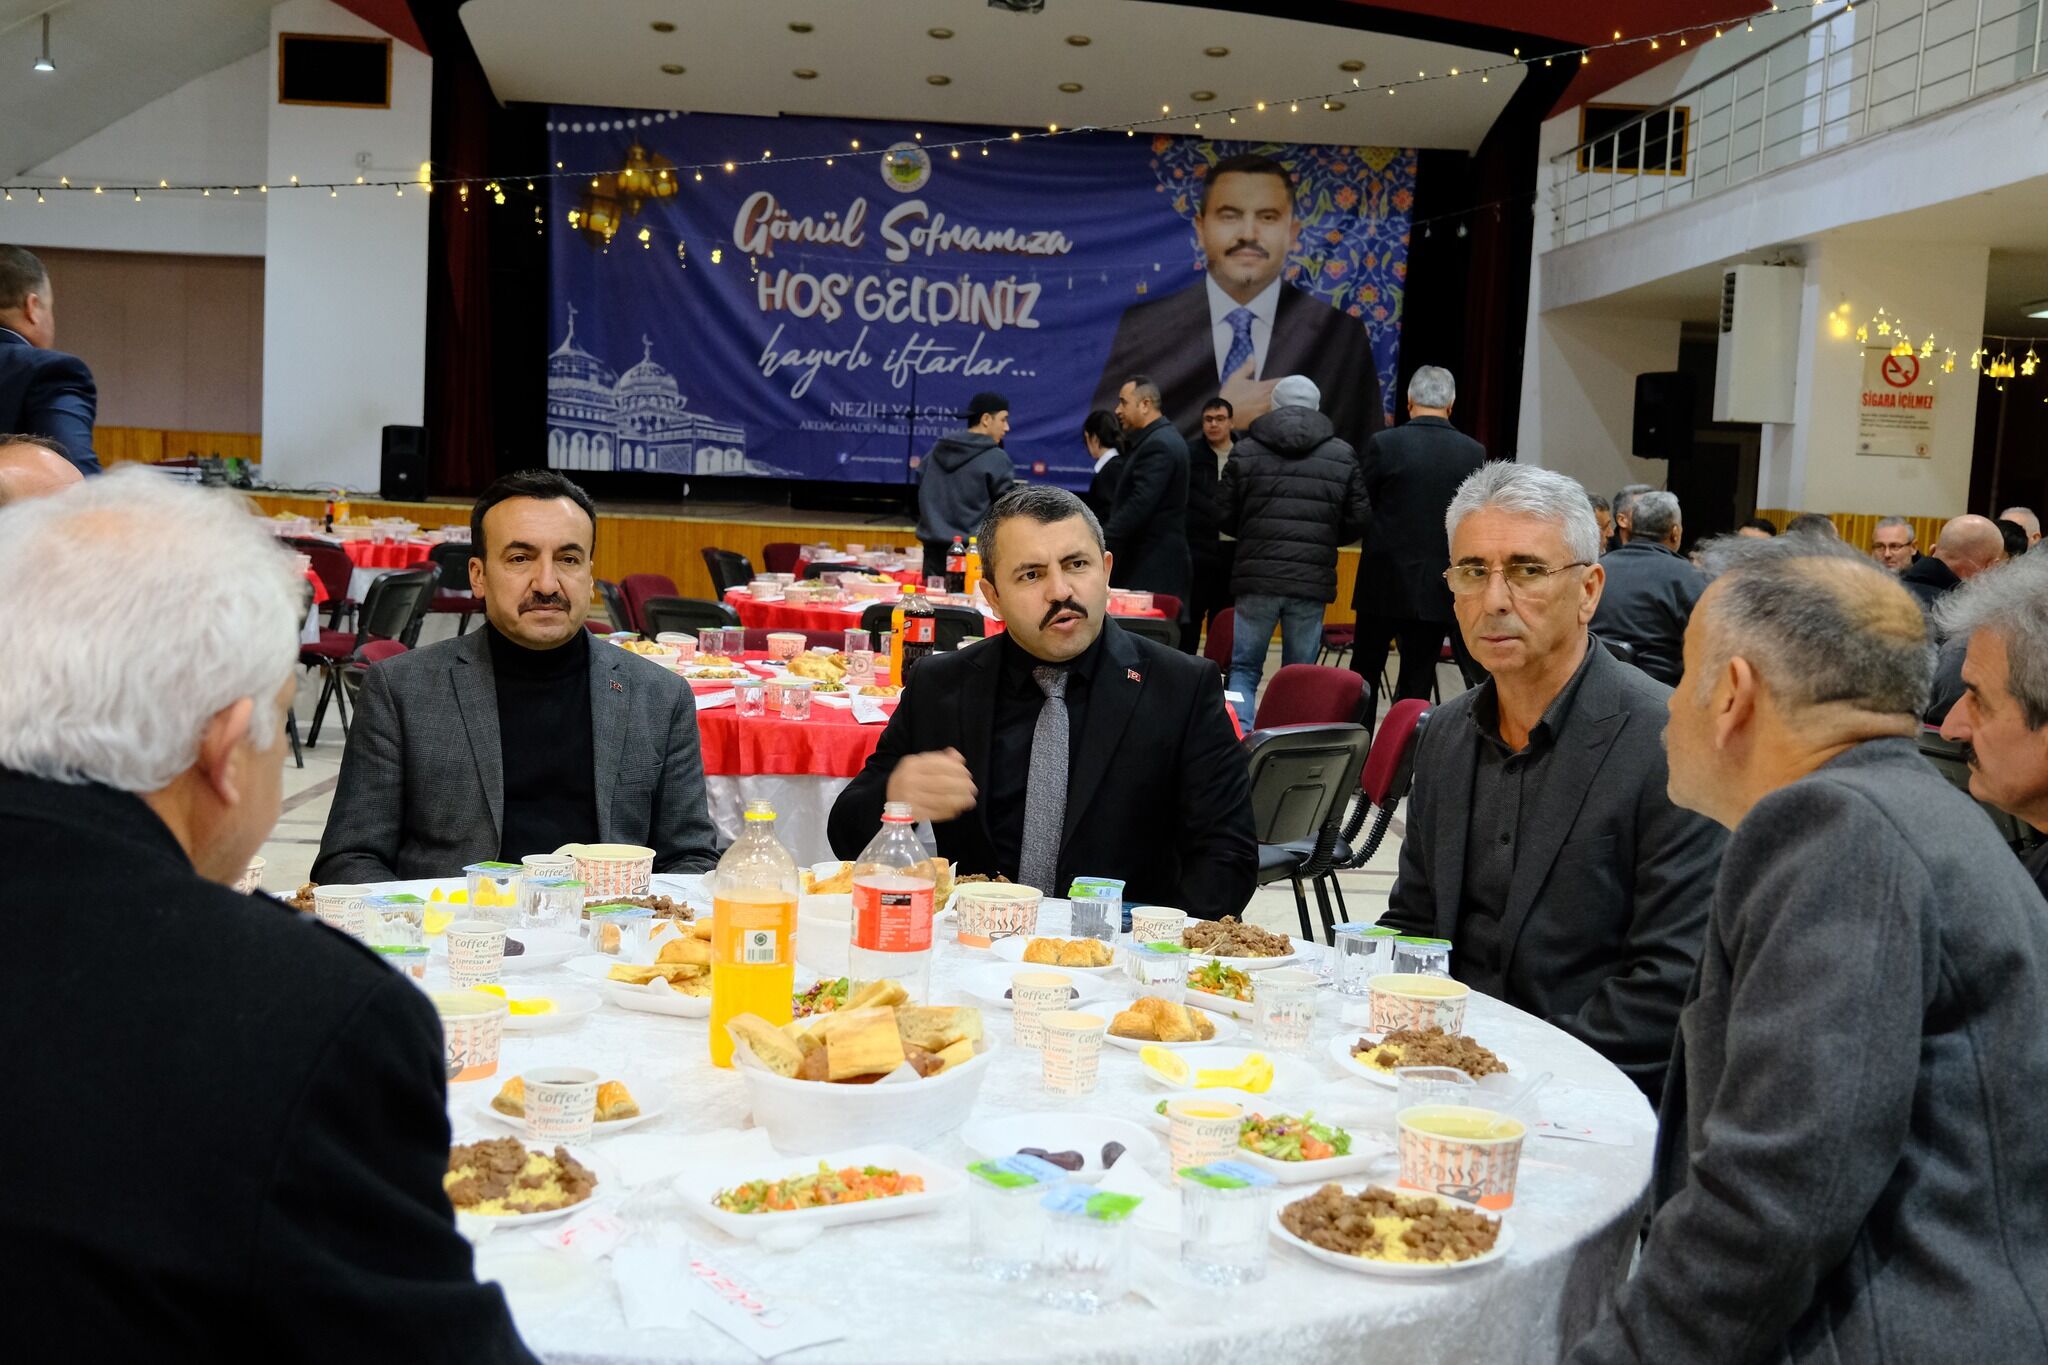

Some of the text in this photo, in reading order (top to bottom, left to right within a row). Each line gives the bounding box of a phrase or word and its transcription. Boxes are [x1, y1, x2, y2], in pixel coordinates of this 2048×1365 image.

[733, 191, 1073, 262] Gönül Soframıza
[758, 268, 1041, 329] HOŞ GELDİNİZ
[1862, 390, 1934, 411] SİGARA İÇİLMEZ
[829, 401, 886, 419] NEZİH
[534, 867, 564, 877] Coffee
[1142, 919, 1174, 931] Coffee
[455, 938, 489, 949] Coffee
[1018, 989, 1052, 1001] Coffee
[538, 1090, 581, 1105] Coffee
[1196, 1123, 1235, 1137] Coffee
